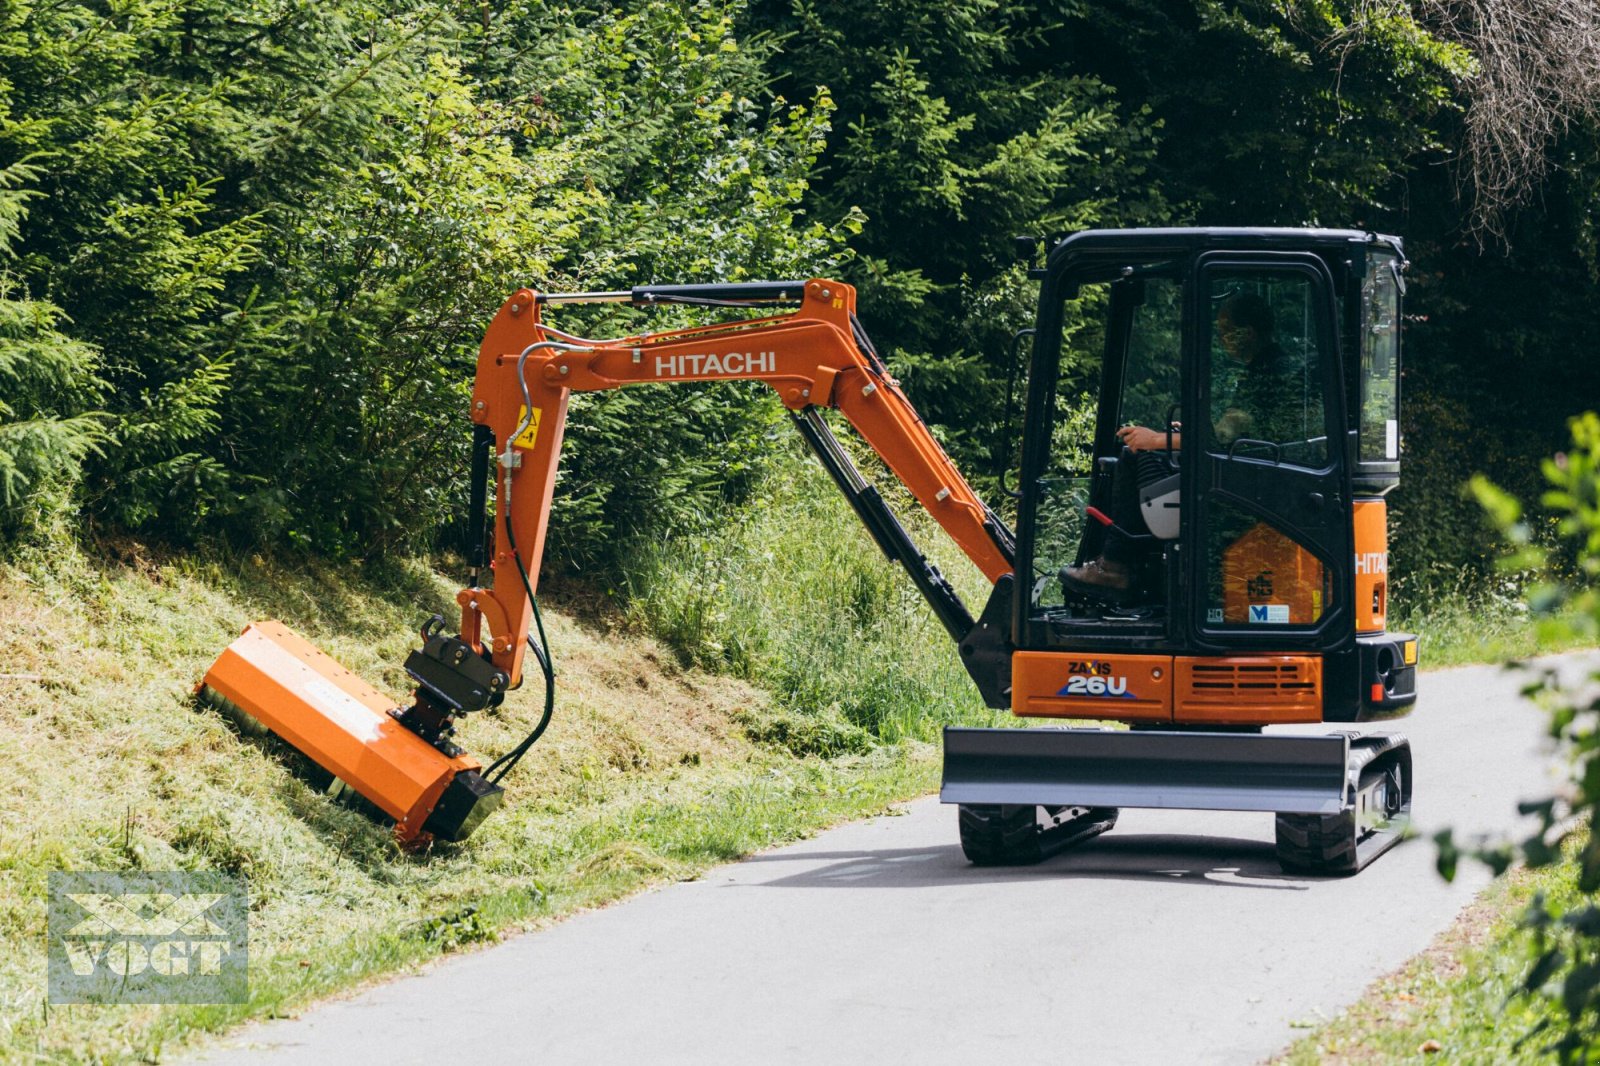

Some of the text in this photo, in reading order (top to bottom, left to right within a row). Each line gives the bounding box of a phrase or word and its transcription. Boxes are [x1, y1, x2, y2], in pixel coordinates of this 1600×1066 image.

[655, 352, 776, 377] HITACHI
[1068, 660, 1112, 675] ZAXIS
[1067, 675, 1127, 695] 26U
